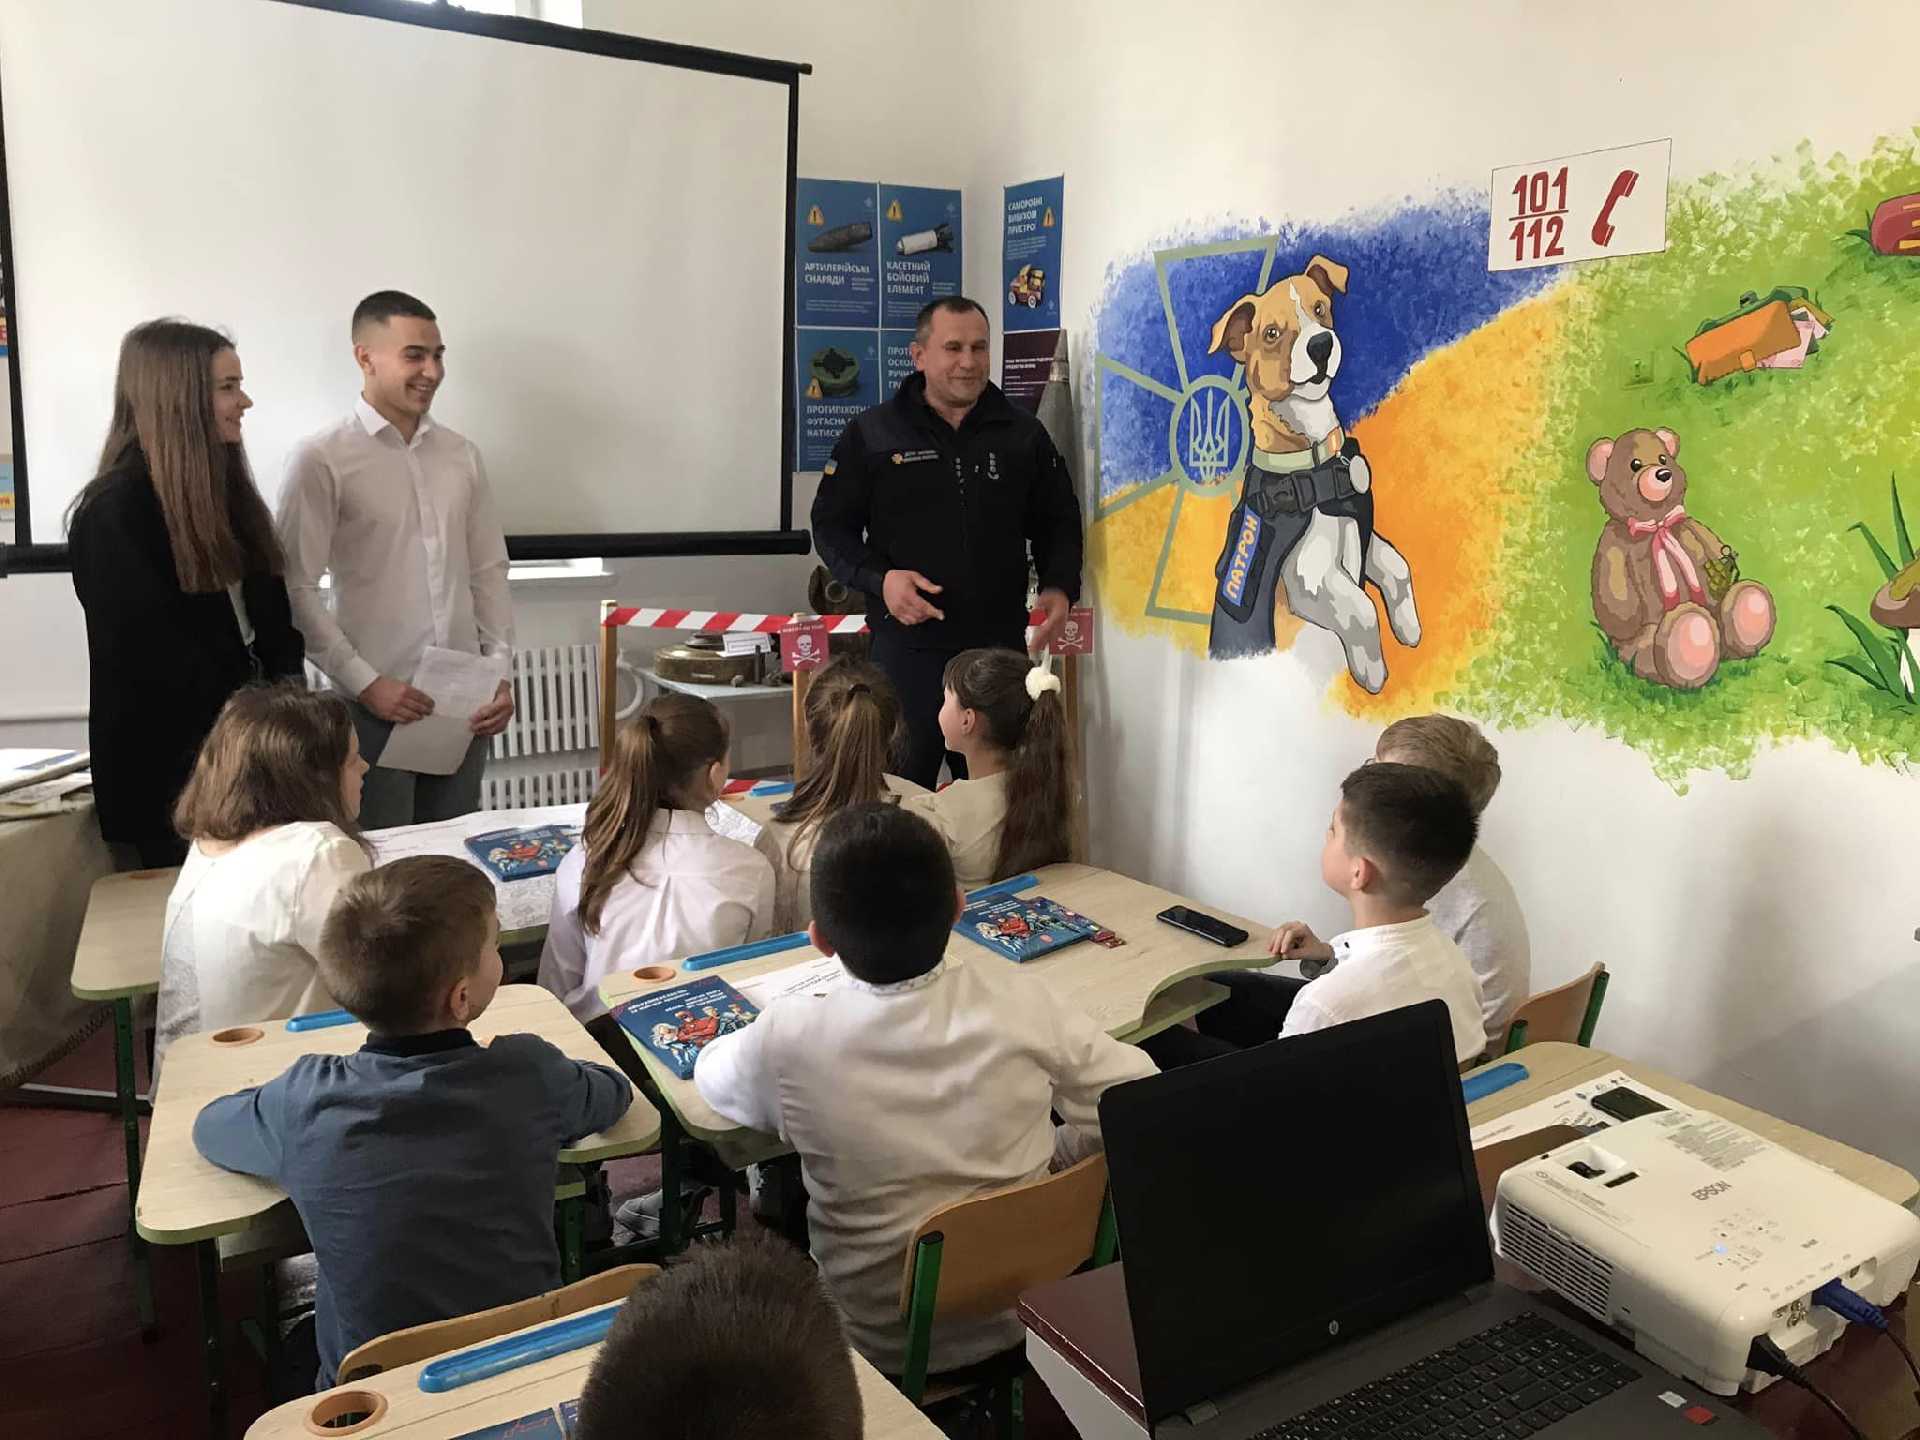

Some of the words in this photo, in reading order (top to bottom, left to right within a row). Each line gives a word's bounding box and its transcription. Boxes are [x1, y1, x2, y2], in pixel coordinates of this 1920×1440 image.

[1512, 166, 1568, 215] 101
[1509, 216, 1564, 261] 112
[886, 260, 931, 271] КАСЕТНИЙ
[804, 274, 845, 286] СНАРЯДИ
[887, 271, 930, 283] БОЙОВИЙ
[887, 284, 924, 295] ЕЛЕМЕНТ
[1226, 515, 1258, 599] ПАТРОН
[1691, 1180, 1732, 1200] EPSON
